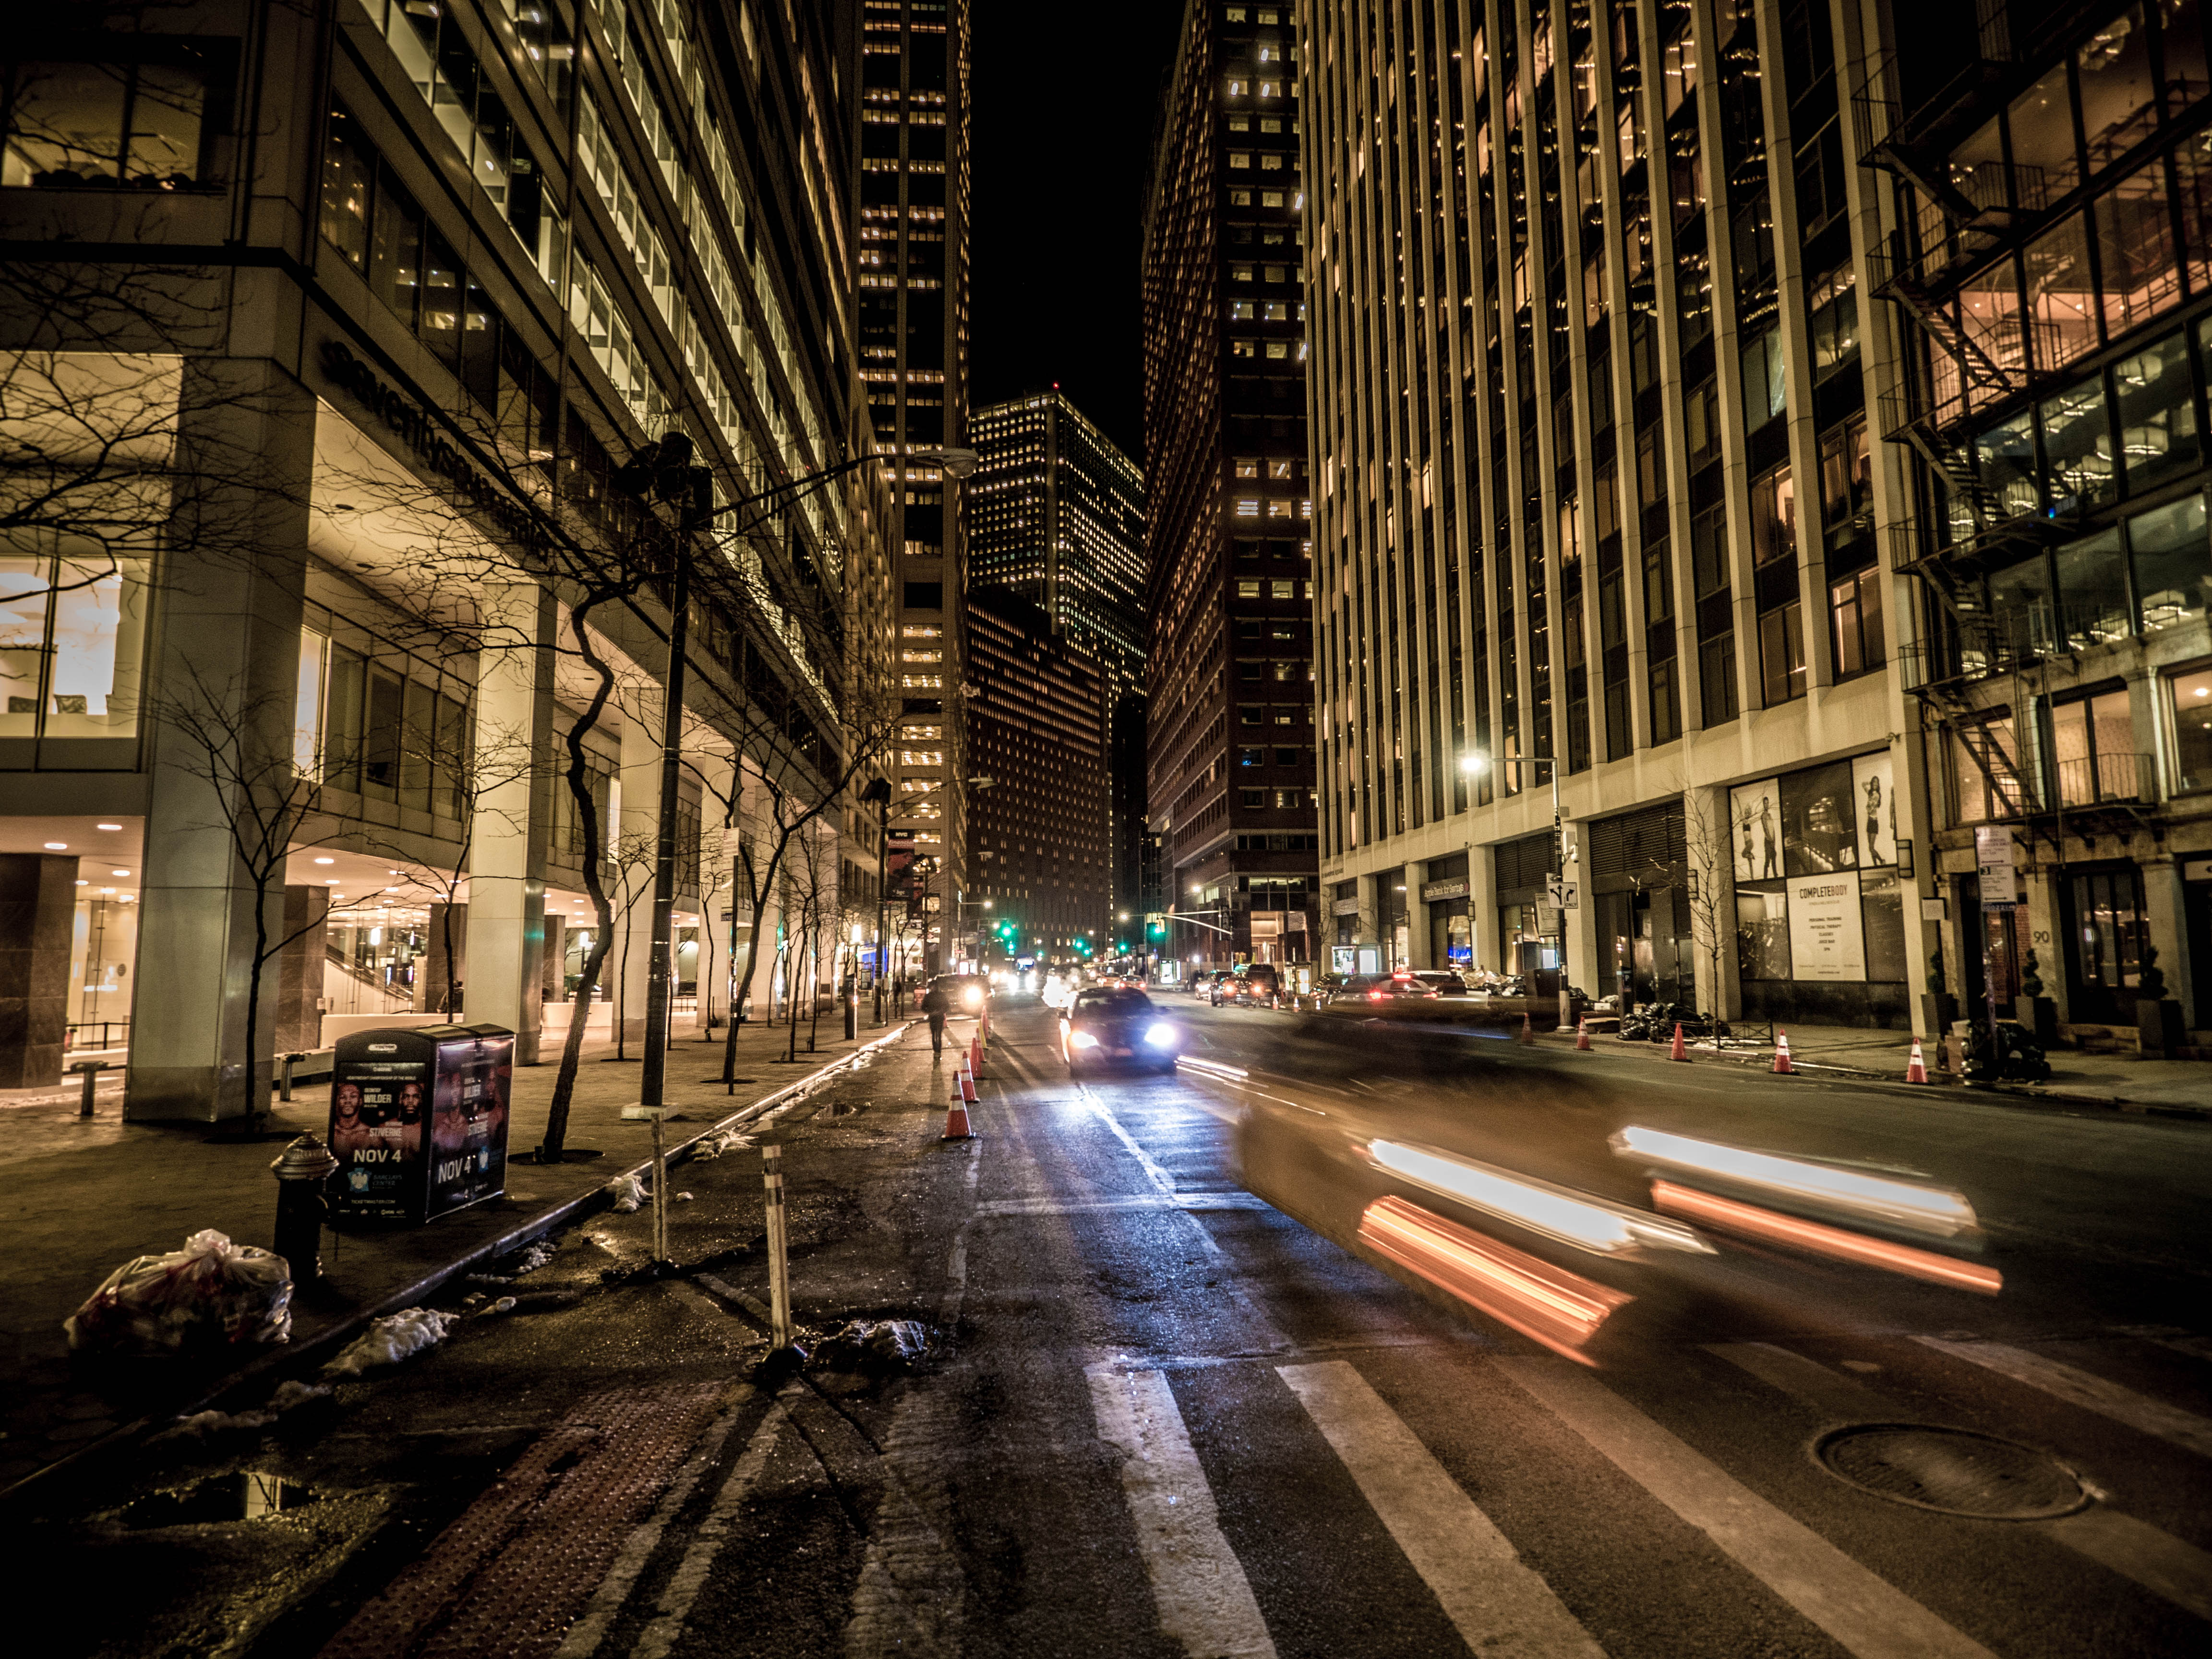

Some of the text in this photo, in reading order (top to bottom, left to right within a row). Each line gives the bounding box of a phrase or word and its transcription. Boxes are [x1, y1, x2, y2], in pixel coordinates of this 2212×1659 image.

[1799, 884, 1848, 899] COMPLETEBODY
[2033, 930, 2050, 943] 90
[363, 1094, 392, 1104] WILDER
[353, 1149, 402, 1163] NOV 4
[437, 1156, 471, 1184] NOV 4
